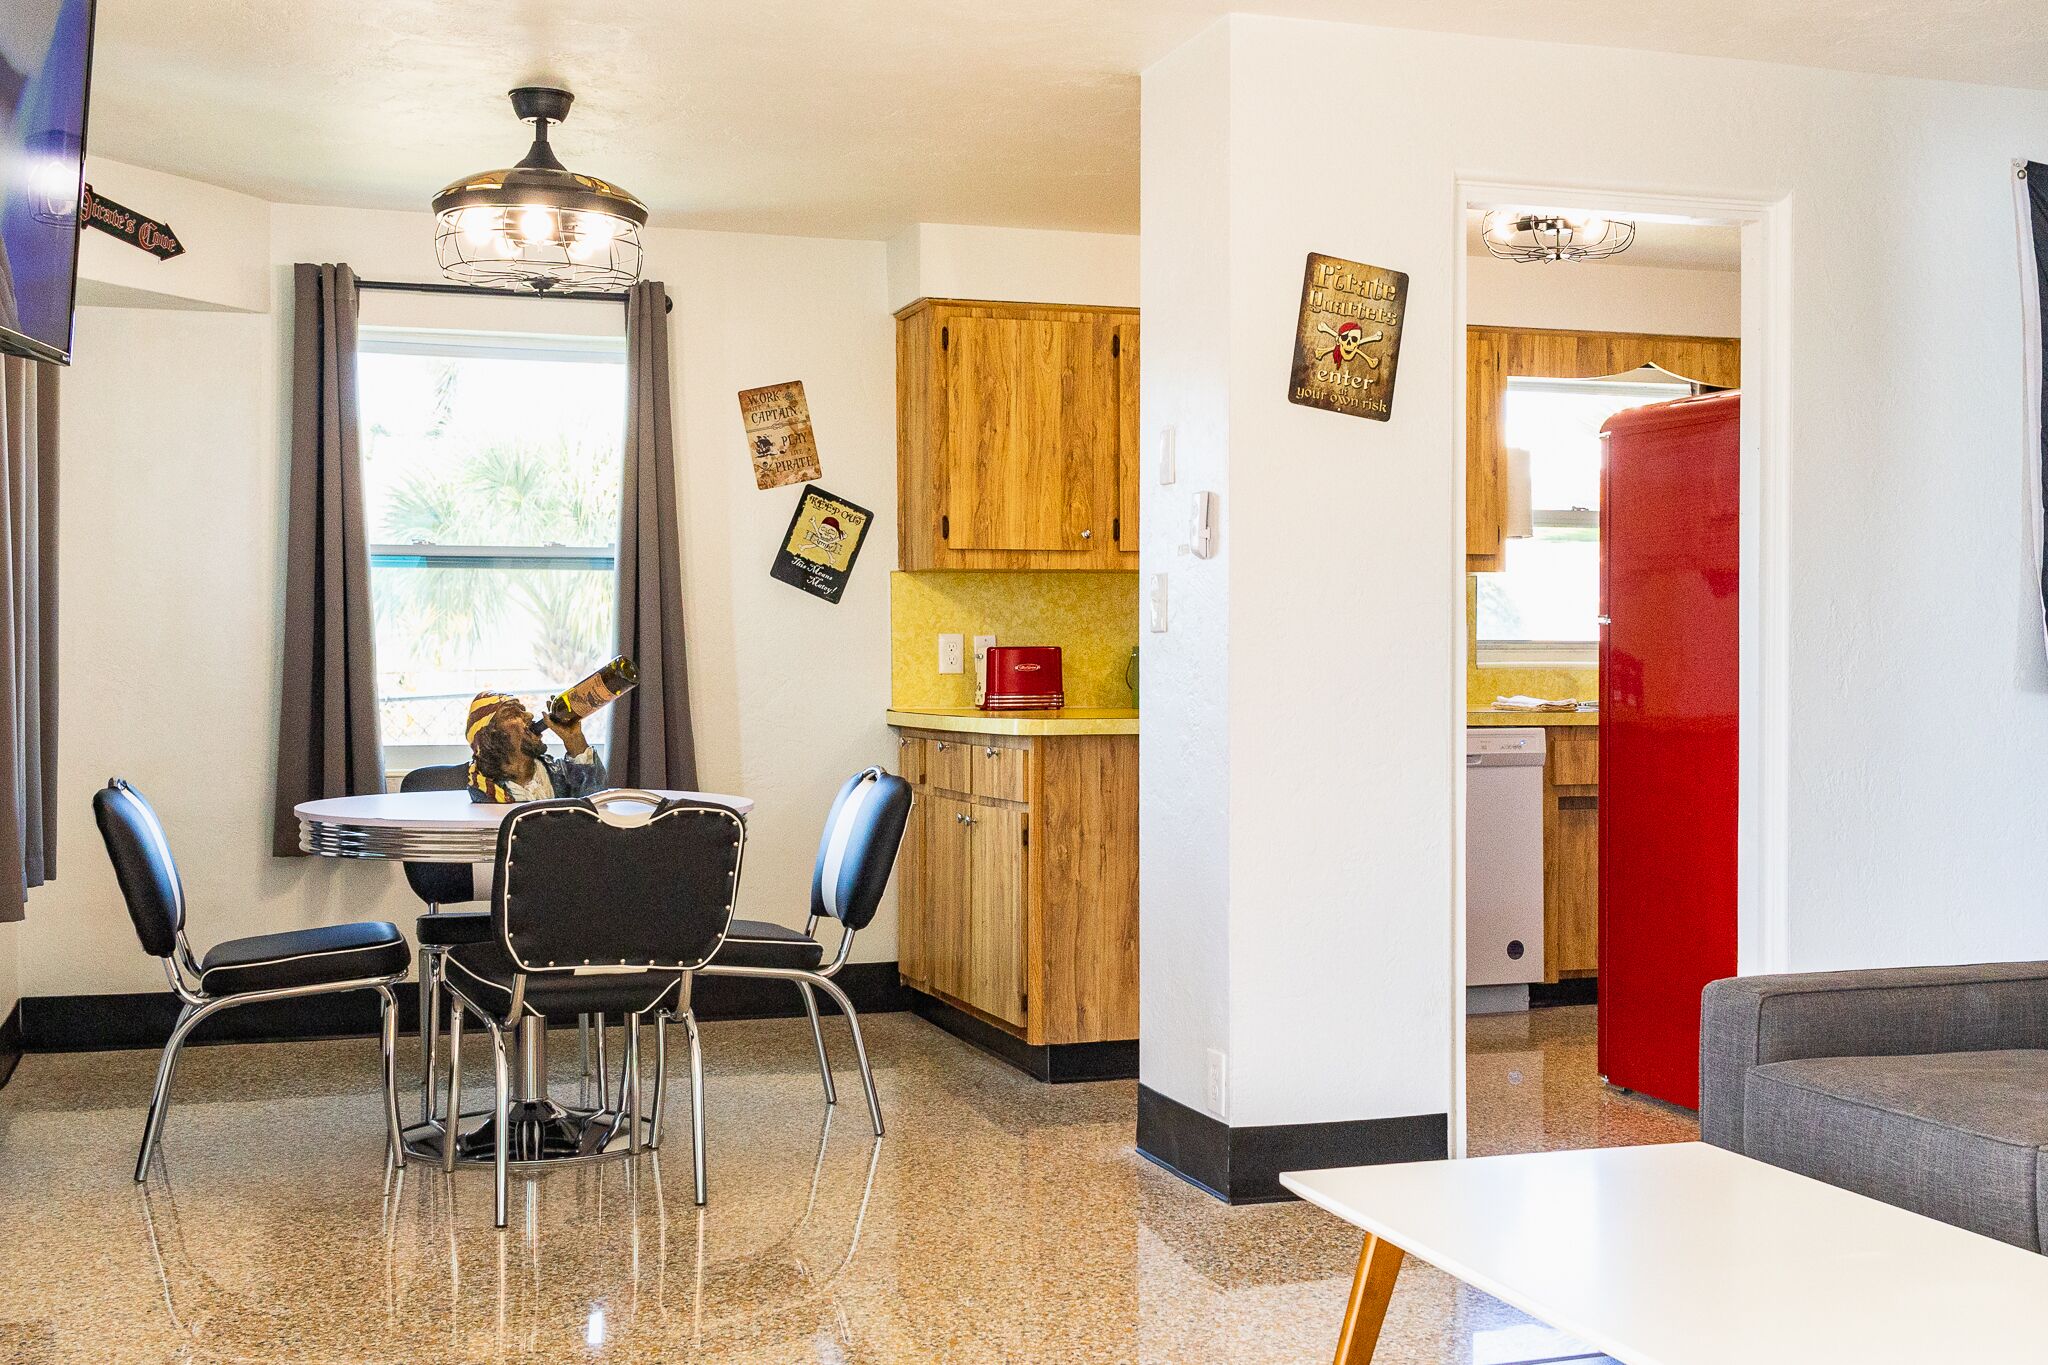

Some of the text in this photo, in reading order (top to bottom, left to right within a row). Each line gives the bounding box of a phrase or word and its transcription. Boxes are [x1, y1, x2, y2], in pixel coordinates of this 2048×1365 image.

[139, 222, 177, 253] Cove
[1314, 263, 1397, 302] Pirate
[1309, 290, 1398, 326] Quarters
[1317, 369, 1375, 390] enter
[747, 391, 781, 405] WORK
[1296, 386, 1387, 413] your own risk
[751, 405, 798, 426] CAPTAIN
[781, 432, 807, 447] PLAY
[775, 456, 815, 472] PIRATE
[809, 495, 840, 515] KEEP
[791, 556, 833, 581] This Means
[806, 575, 838, 595] Matey!
